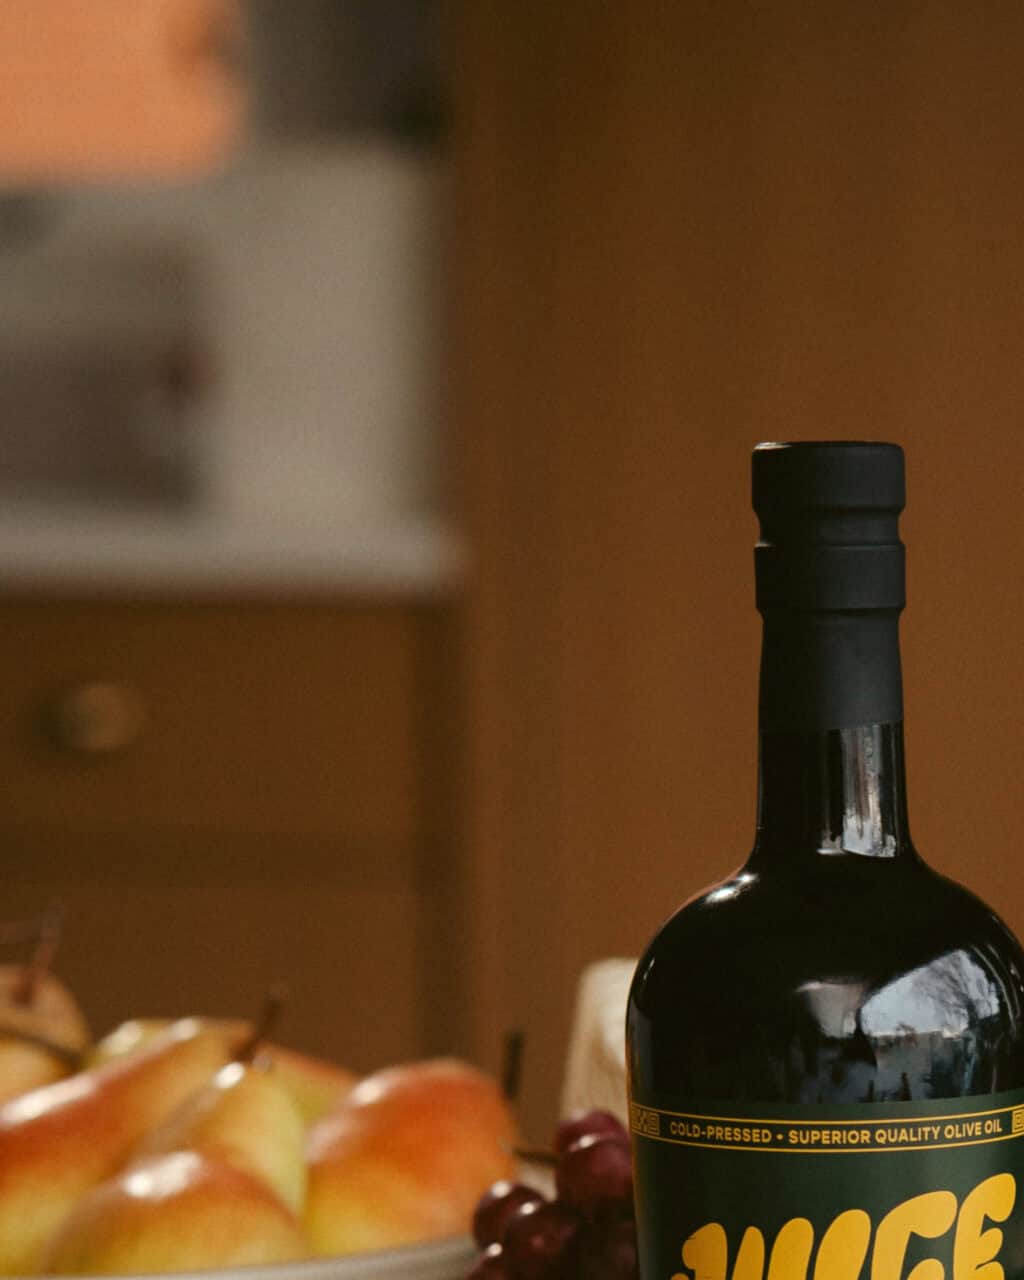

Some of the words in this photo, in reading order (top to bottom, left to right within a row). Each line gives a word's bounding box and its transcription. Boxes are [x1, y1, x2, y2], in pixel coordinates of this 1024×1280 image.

[670, 1121, 772, 1144] COLD-PRESSED
[788, 1129, 871, 1145] SUPERIOR
[875, 1126, 941, 1145] QUALITY
[944, 1121, 983, 1139] OLIVE
[984, 1118, 1003, 1135] OIL
